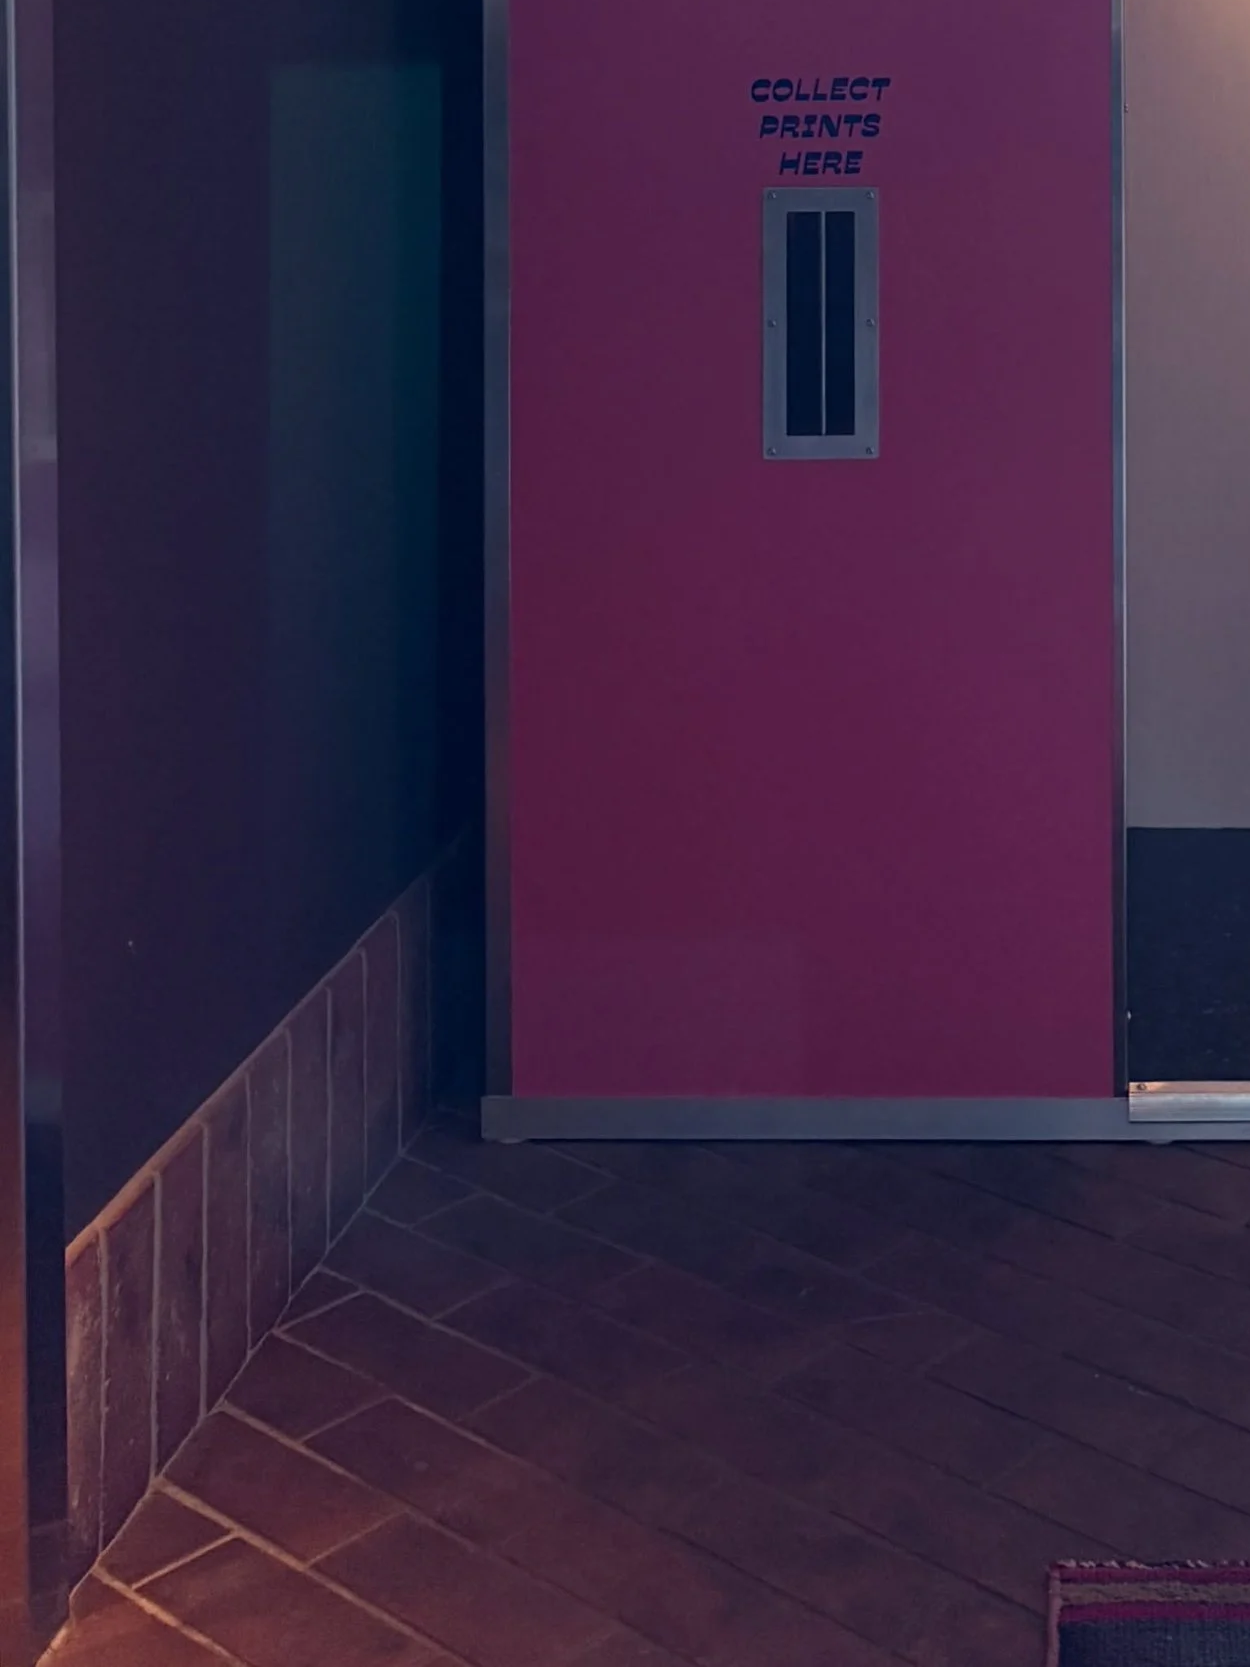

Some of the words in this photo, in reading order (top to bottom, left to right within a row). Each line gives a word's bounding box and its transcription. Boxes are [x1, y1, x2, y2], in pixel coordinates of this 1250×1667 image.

[752, 77, 891, 102] COLLECT
[760, 113, 880, 138] PRINTS
[779, 151, 863, 175] HERE
